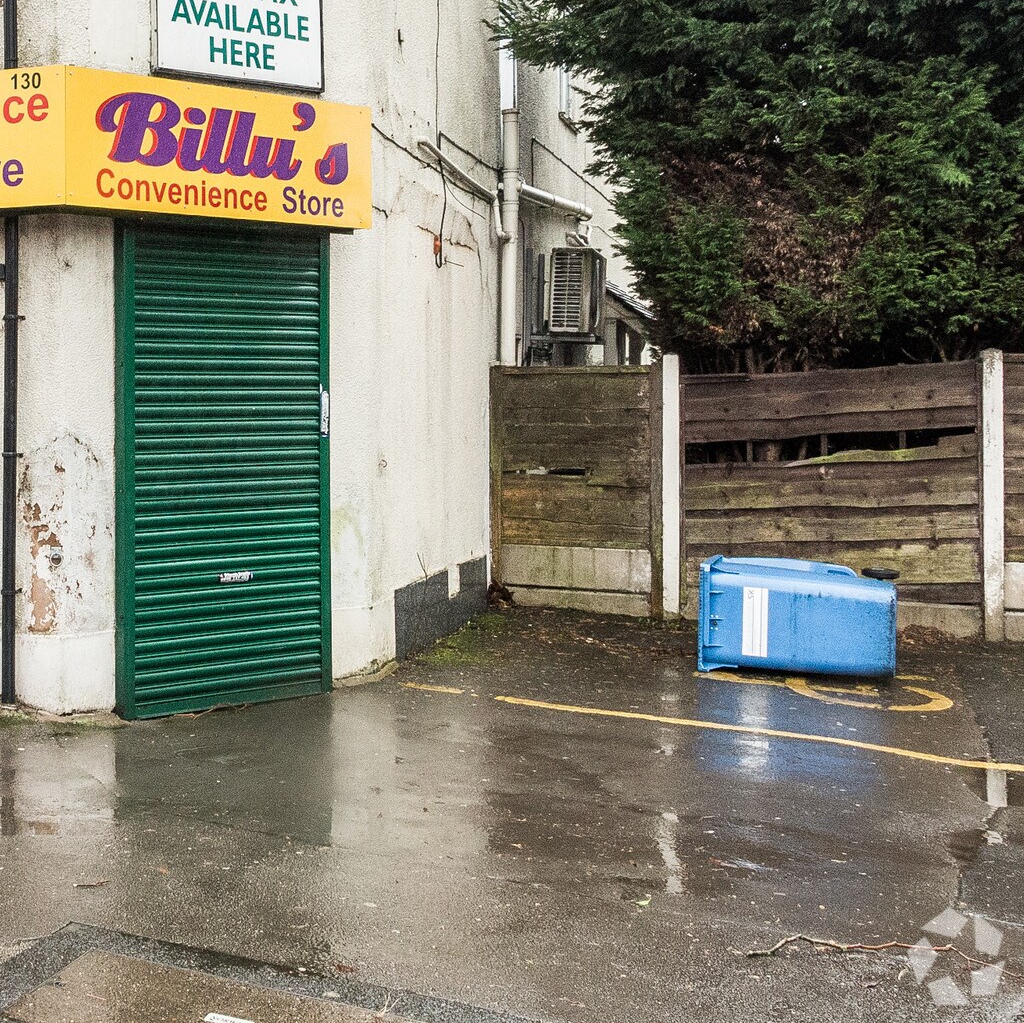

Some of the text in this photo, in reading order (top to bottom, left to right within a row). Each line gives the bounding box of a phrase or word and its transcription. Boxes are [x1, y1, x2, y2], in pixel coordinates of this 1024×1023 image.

[209, 36, 275, 71] HERE
[10, 72, 41, 90] 130
[96, 168, 344, 217] Convenience Store
